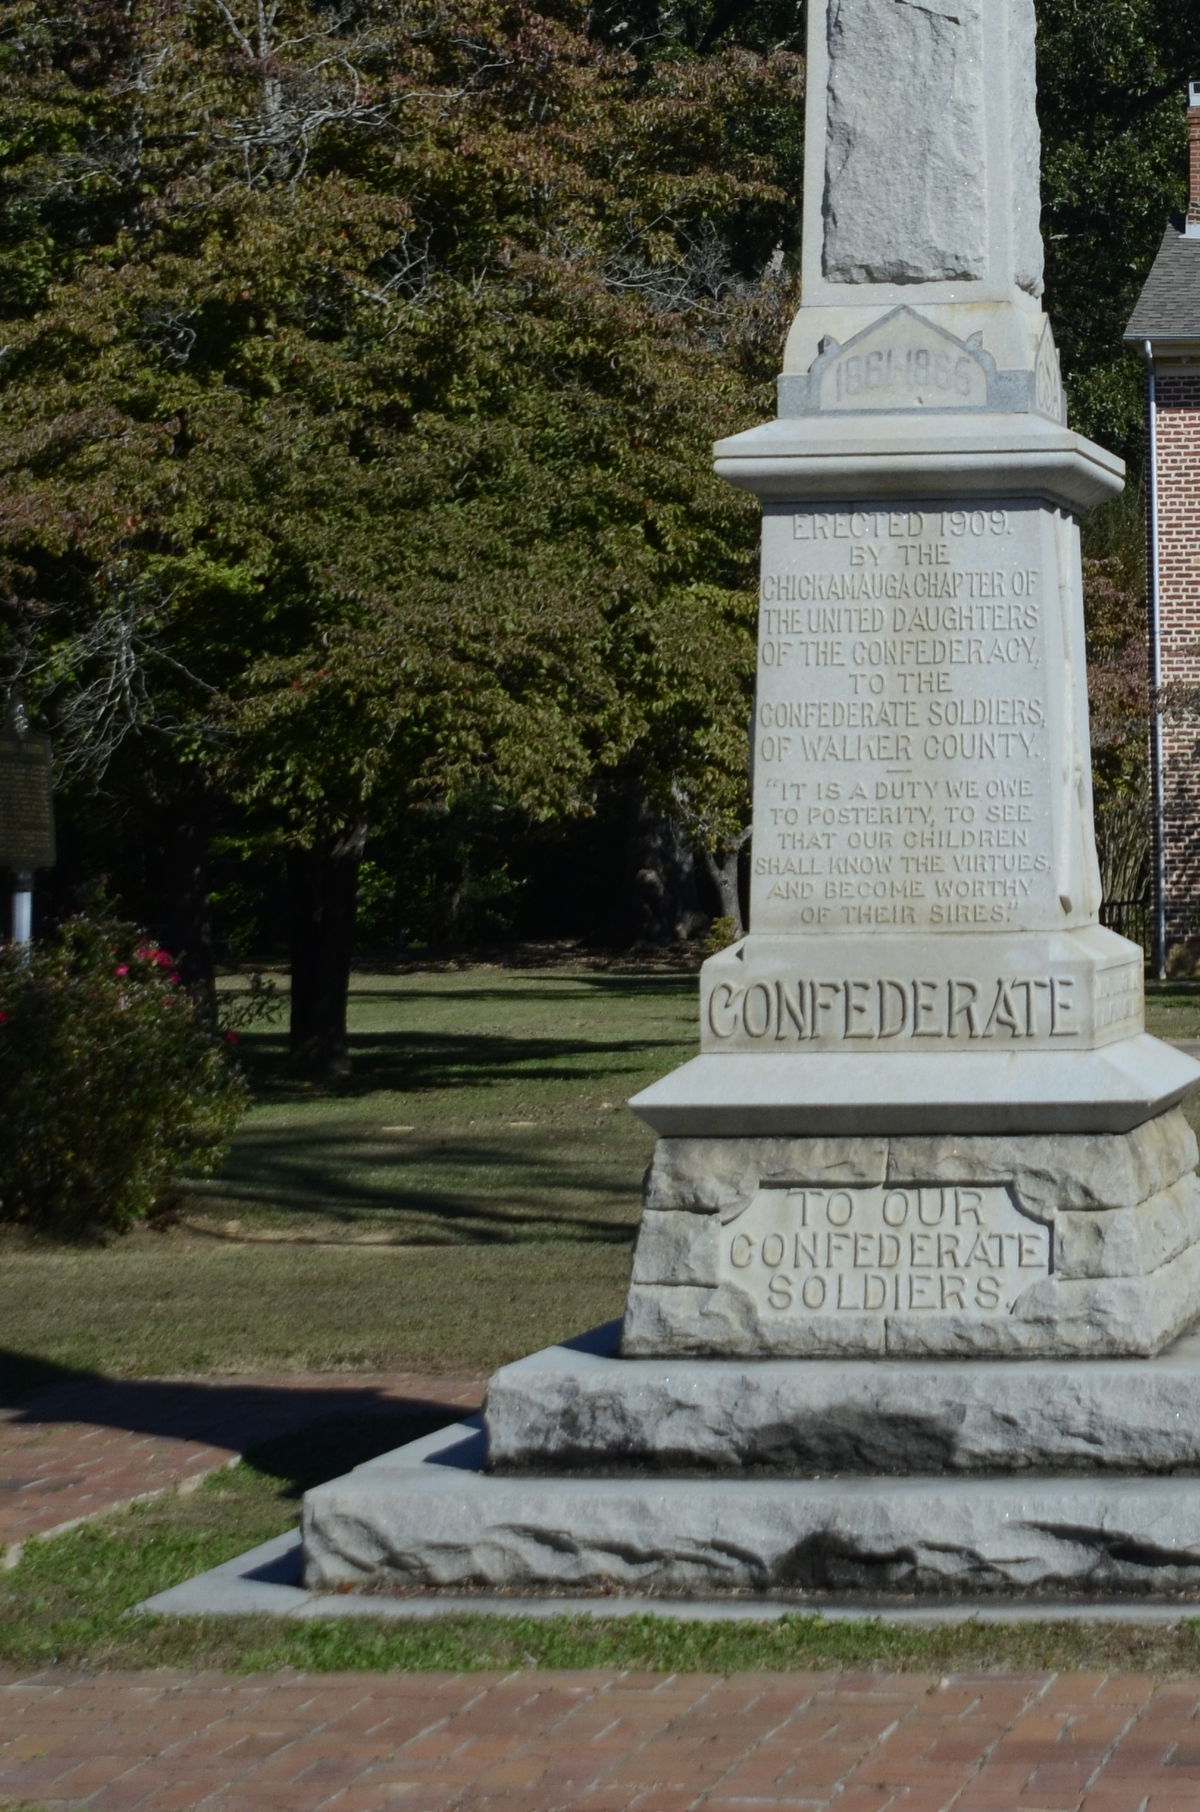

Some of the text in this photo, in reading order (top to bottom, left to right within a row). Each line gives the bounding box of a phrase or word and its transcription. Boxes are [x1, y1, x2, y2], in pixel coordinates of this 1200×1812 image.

[793, 510, 1013, 540] ERECTED 1909.
[850, 544, 950, 567] BY THE
[762, 570, 1039, 601] CHICKAMAUGA CHAPTER OF
[763, 604, 1040, 635] THE UNITED DAUGHTERS
[762, 637, 1041, 669] OF THE CONFEDERACY,
[849, 672, 953, 694] TO THE
[760, 699, 1046, 728] CONFEDERATE SOLDIERS,
[761, 732, 1041, 762] OF WALKER COUNTY.
[817, 782, 841, 800] IS
[849, 782, 868, 800] A
[875, 781, 939, 800] DUTY
[946, 780, 980, 799] WE
[986, 779, 1034, 798] OWE
[770, 804, 1033, 828] TO POSTERITY, TO SEE
[778, 829, 1028, 850] THAT OUR CHILDREN
[754, 853, 1052, 875] SHALL KNOW THE VIRTUES,
[767, 878, 1034, 900] AND BECOME WORTHY
[800, 906, 831, 925] OF
[841, 905, 917, 924] THEIR
[707, 976, 1080, 1040] CONFEDERATE
[786, 1188, 987, 1228] TO OUR
[729, 1231, 1047, 1269] CONFEDERATE
[767, 1273, 1011, 1310] SOLDIERS.
